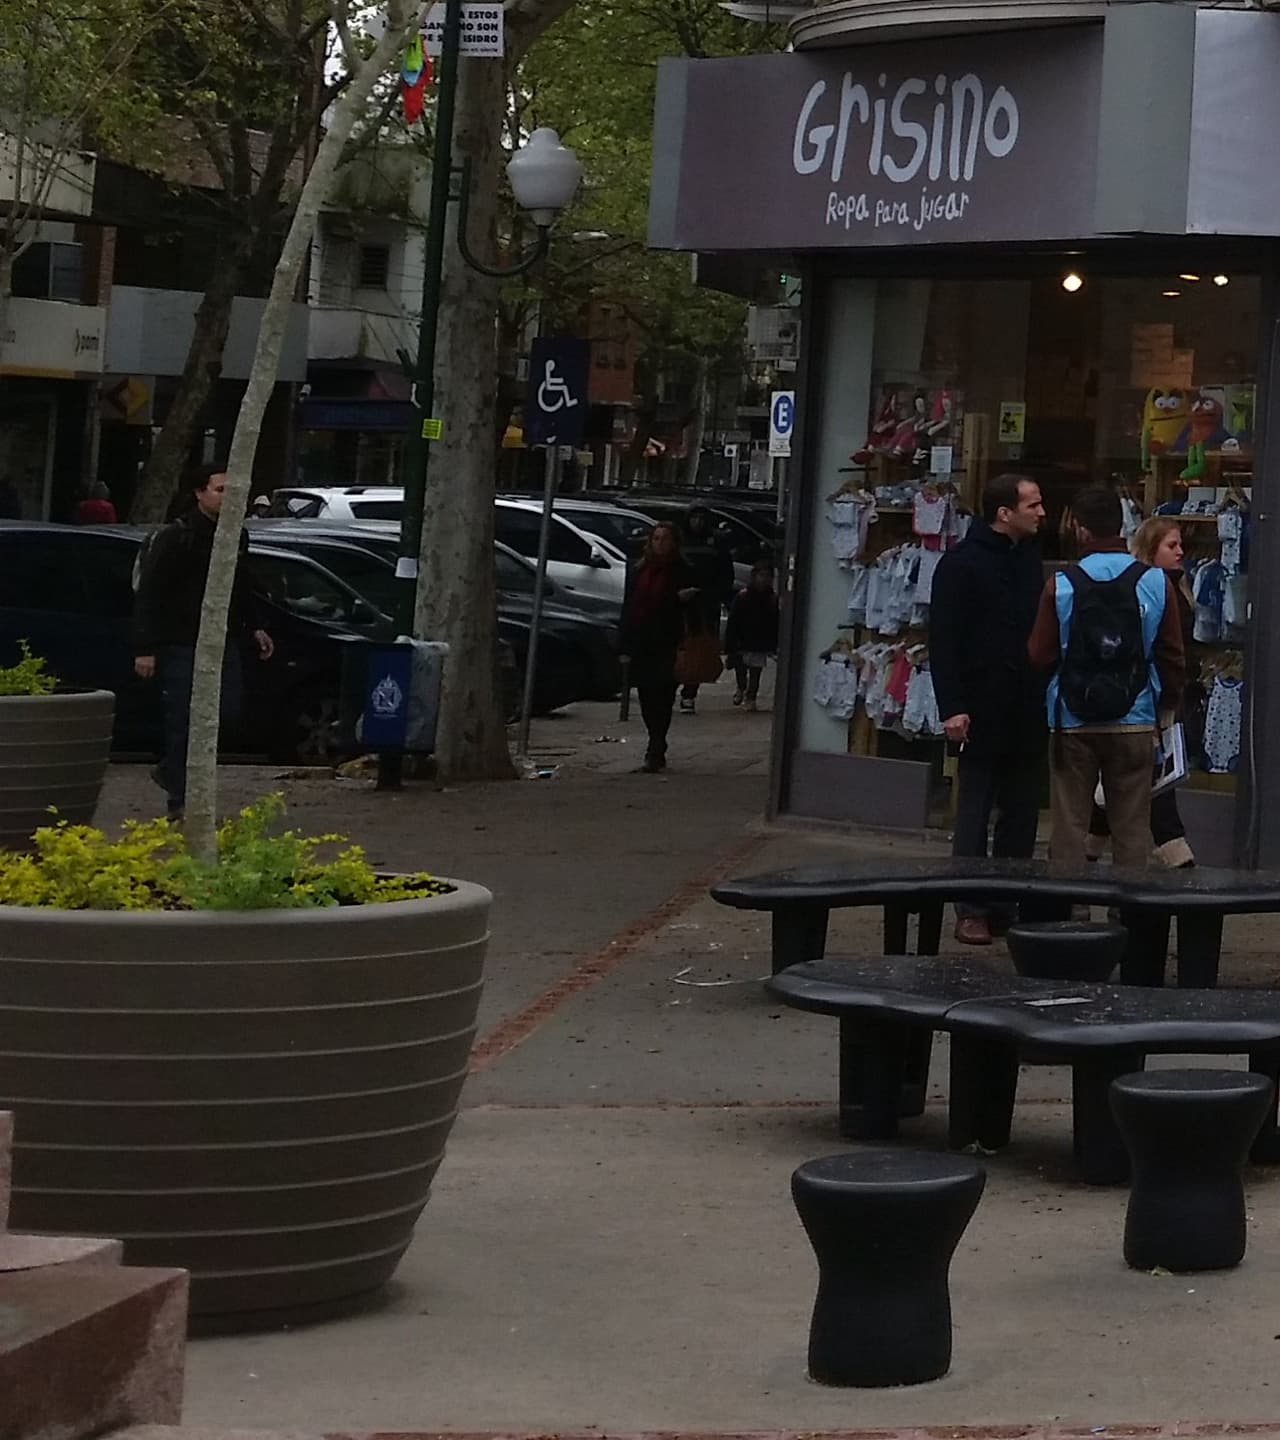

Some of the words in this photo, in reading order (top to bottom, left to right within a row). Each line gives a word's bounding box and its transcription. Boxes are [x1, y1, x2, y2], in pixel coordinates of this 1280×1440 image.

[468, 11, 498, 19] ESTOS
[477, 23, 498, 31] SON
[464, 35, 498, 43] ISIDRO
[793, 71, 1019, 183] Grisino
[826, 191, 869, 229] Ropa
[875, 200, 909, 227] para
[913, 186, 969, 231] jugar
